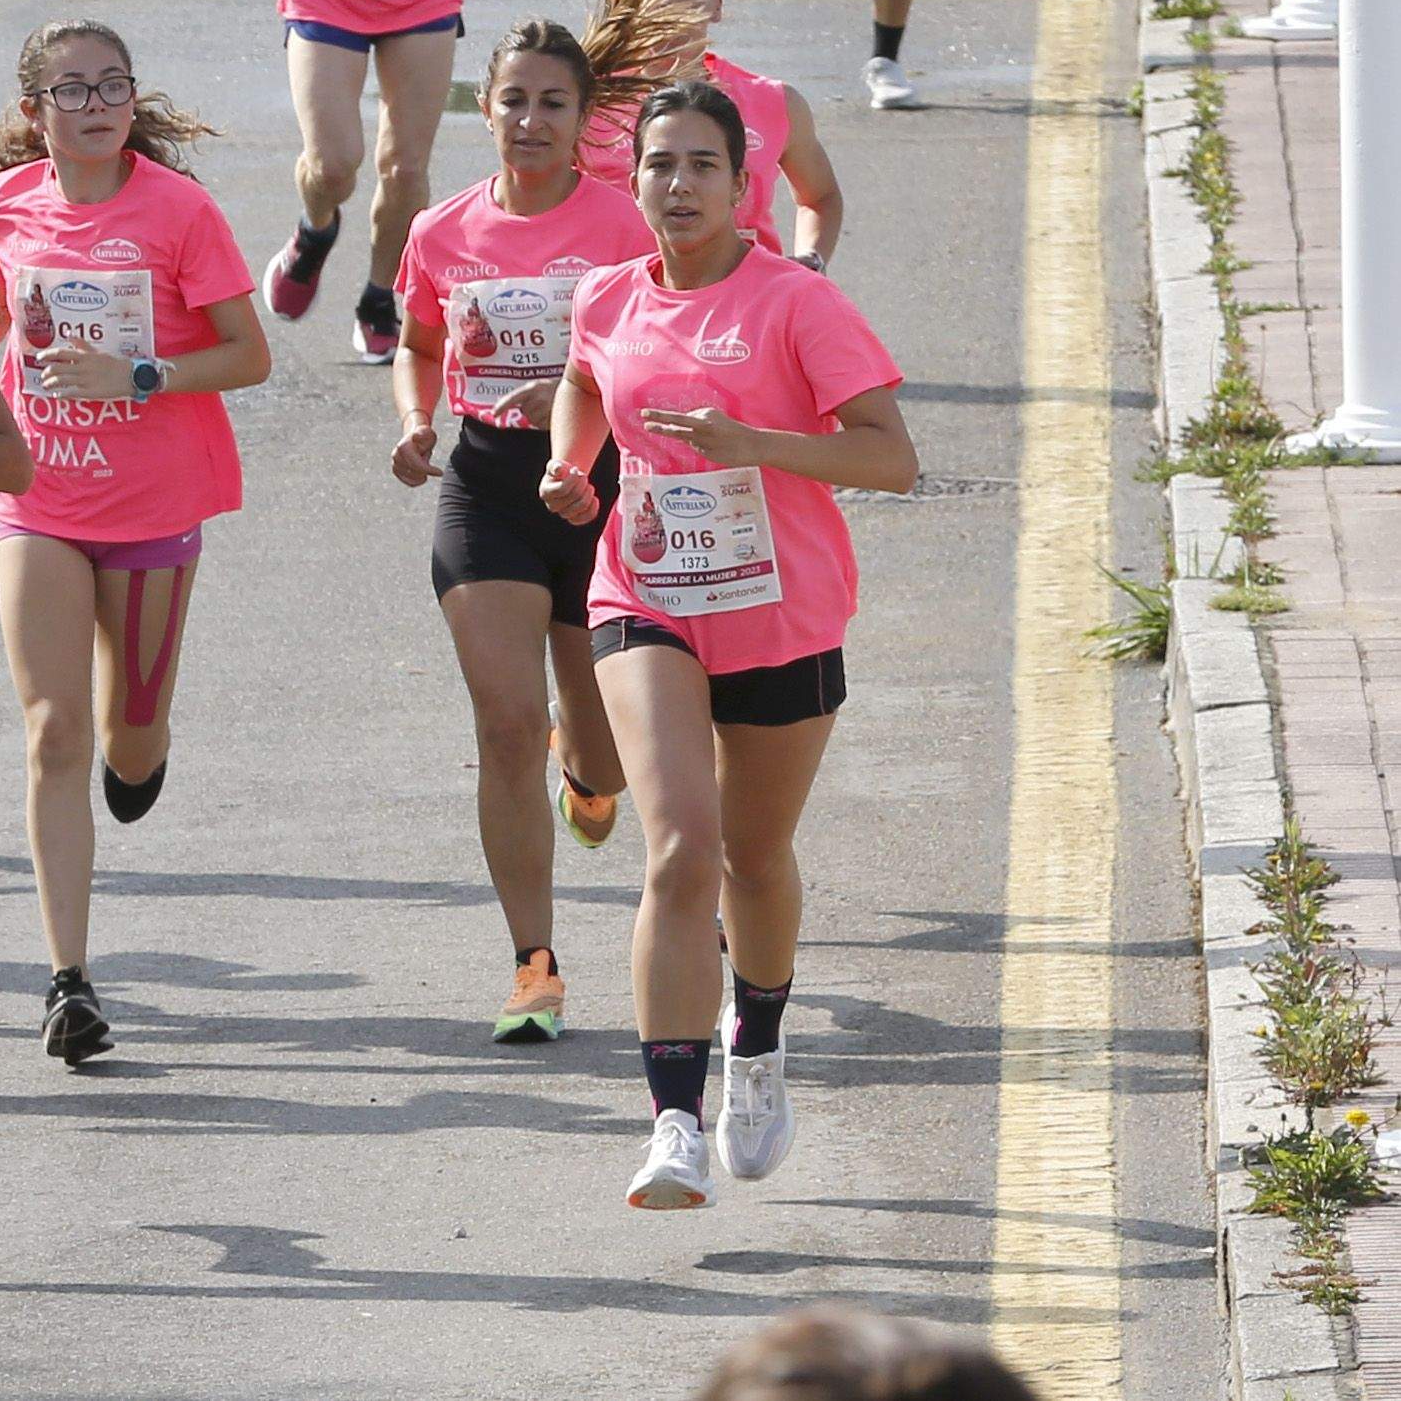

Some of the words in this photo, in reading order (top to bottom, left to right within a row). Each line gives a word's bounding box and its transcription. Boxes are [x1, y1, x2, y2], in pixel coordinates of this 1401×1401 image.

[445, 263, 499, 279] OYSHO
[548, 267, 587, 277] ASTURIAN
[55, 292, 104, 305] ASTURIANA
[113, 288, 141, 297] SUMA
[491, 300, 544, 313] ASTURIANA
[58, 321, 104, 341] 016
[499, 329, 545, 347] 016
[29, 396, 141, 427] ORSAL
[721, 486, 752, 498] SUMA
[665, 498, 712, 511] ASTURIANA
[671, 530, 716, 549] 016
[681, 556, 710, 568] 1373
[705, 570, 737, 581] MUJER
[718, 585, 768, 601] Santander
